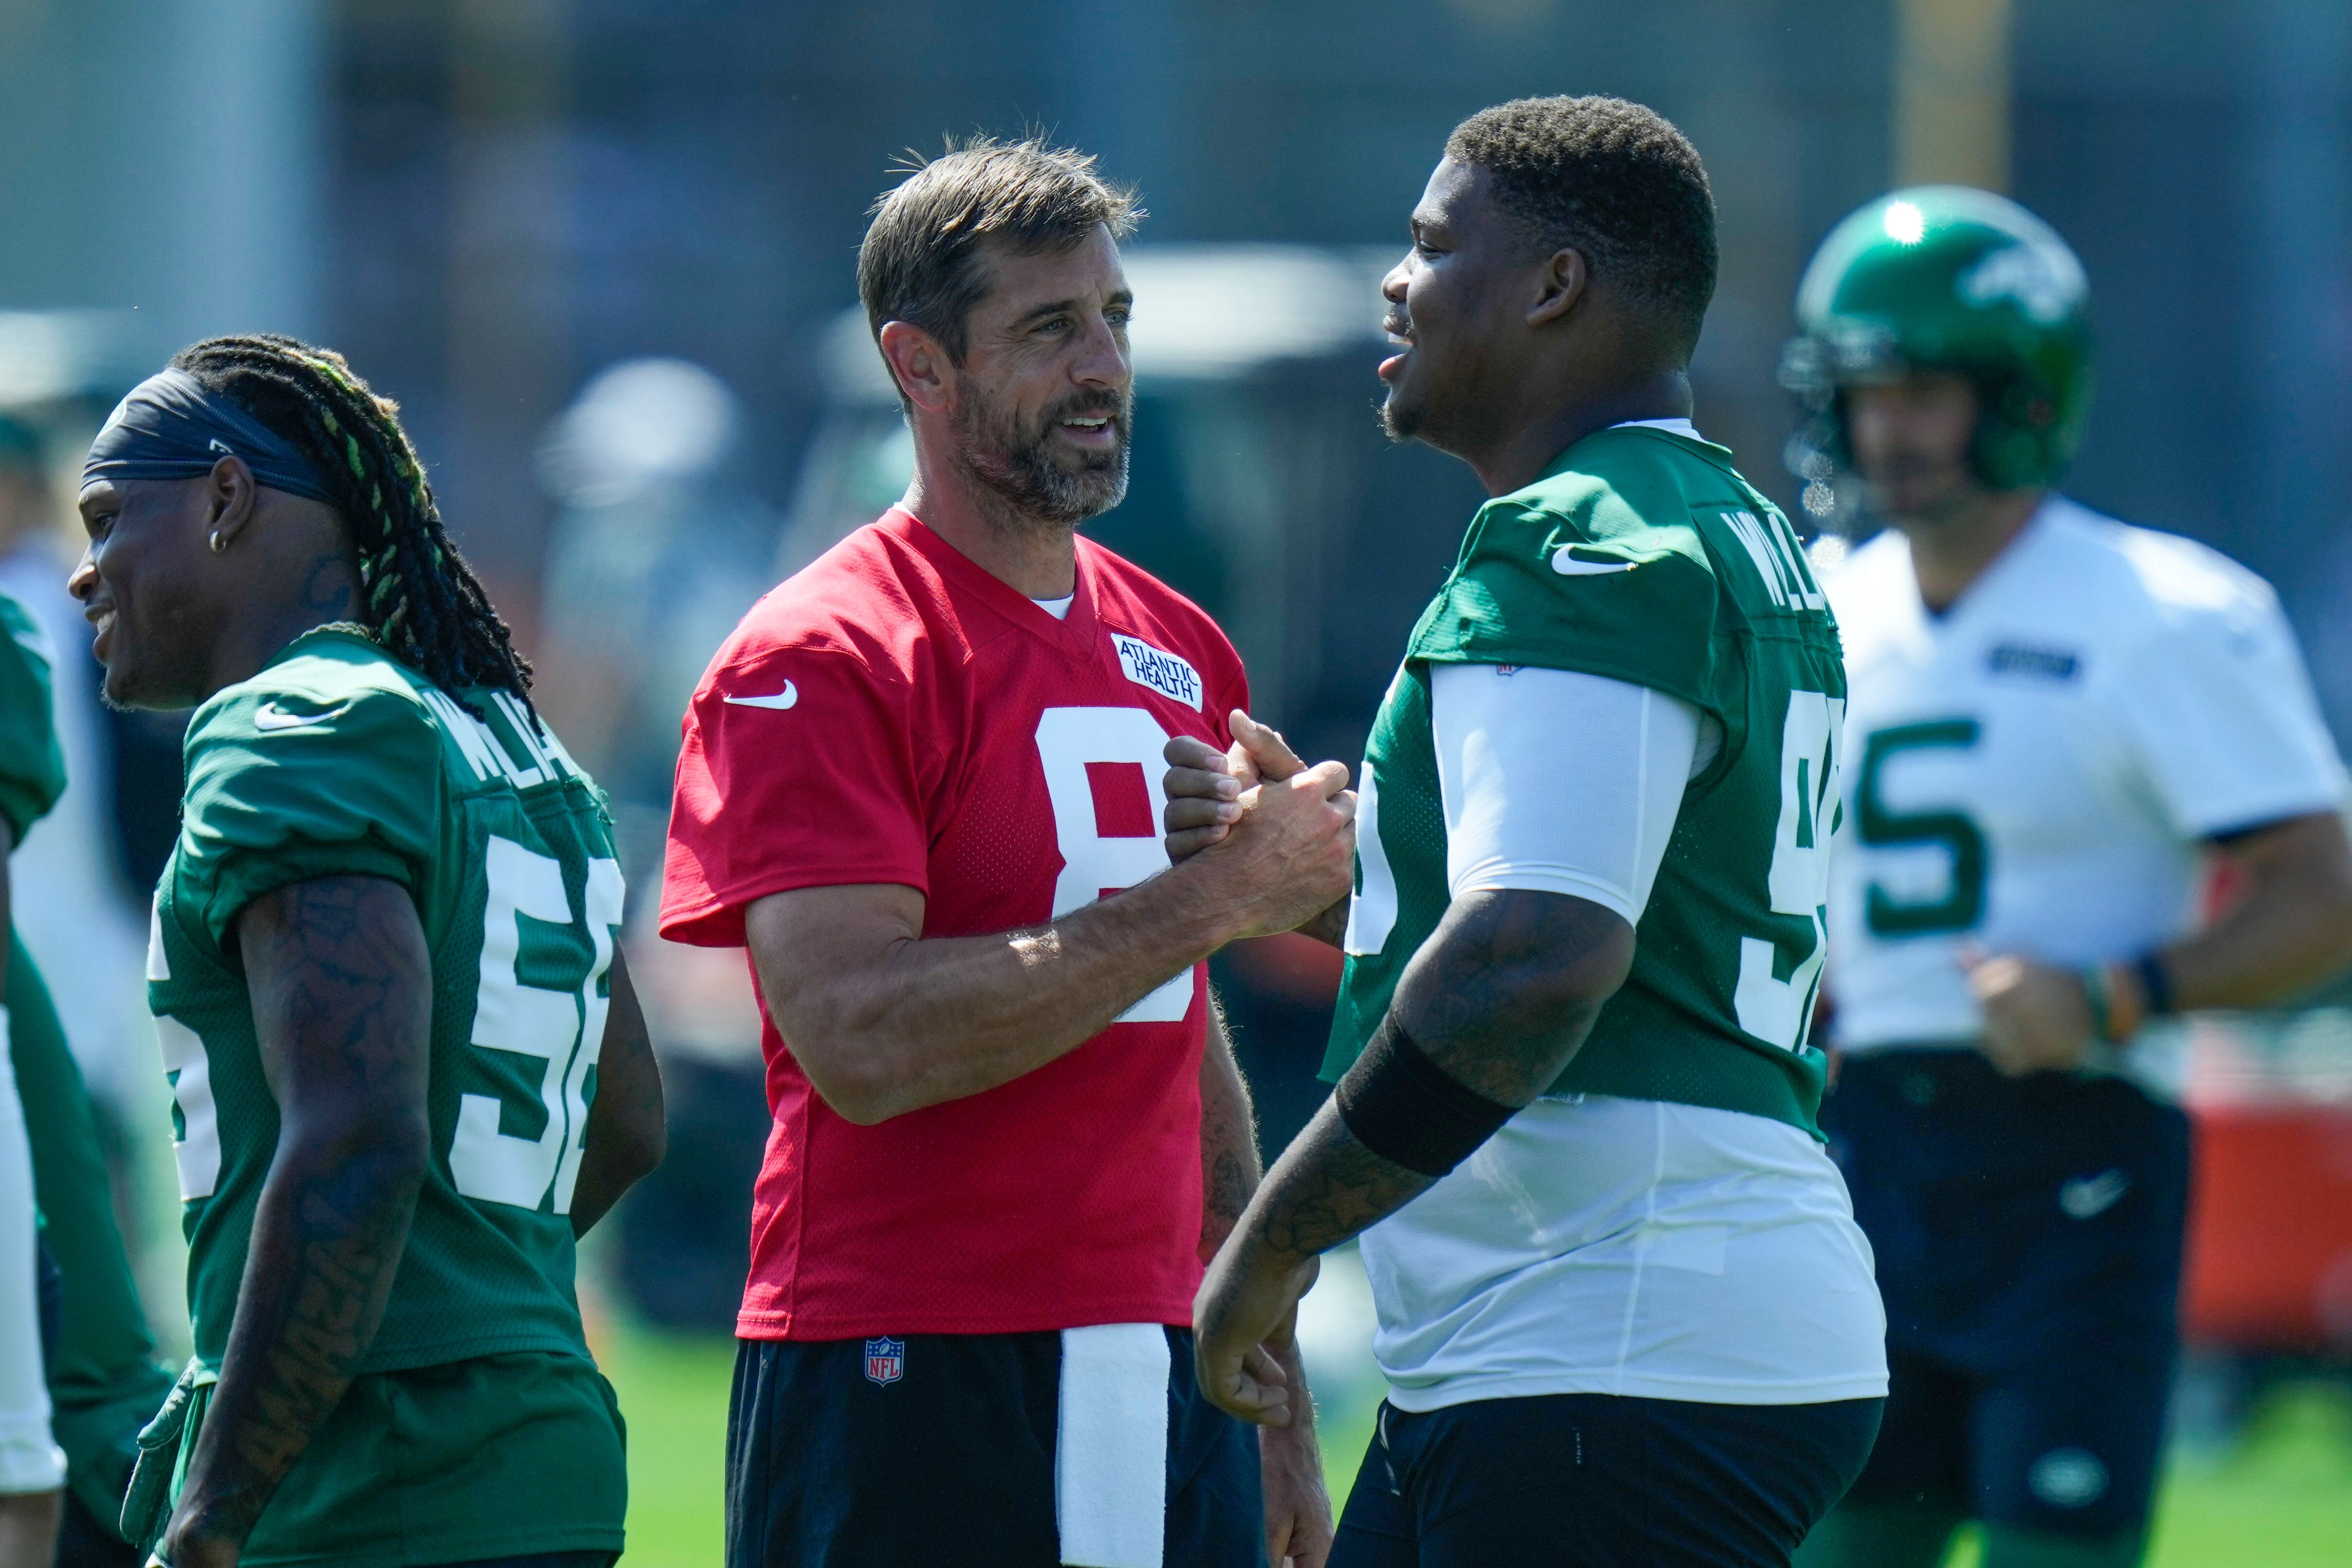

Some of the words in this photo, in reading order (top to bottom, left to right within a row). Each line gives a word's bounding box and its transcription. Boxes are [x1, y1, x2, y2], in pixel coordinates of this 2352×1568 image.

[1120, 640, 1199, 686] ATLANTIC
[1134, 659, 1194, 702] HEALTH
[1858, 719, 1987, 936] 5
[869, 1357, 899, 1380] NFL
